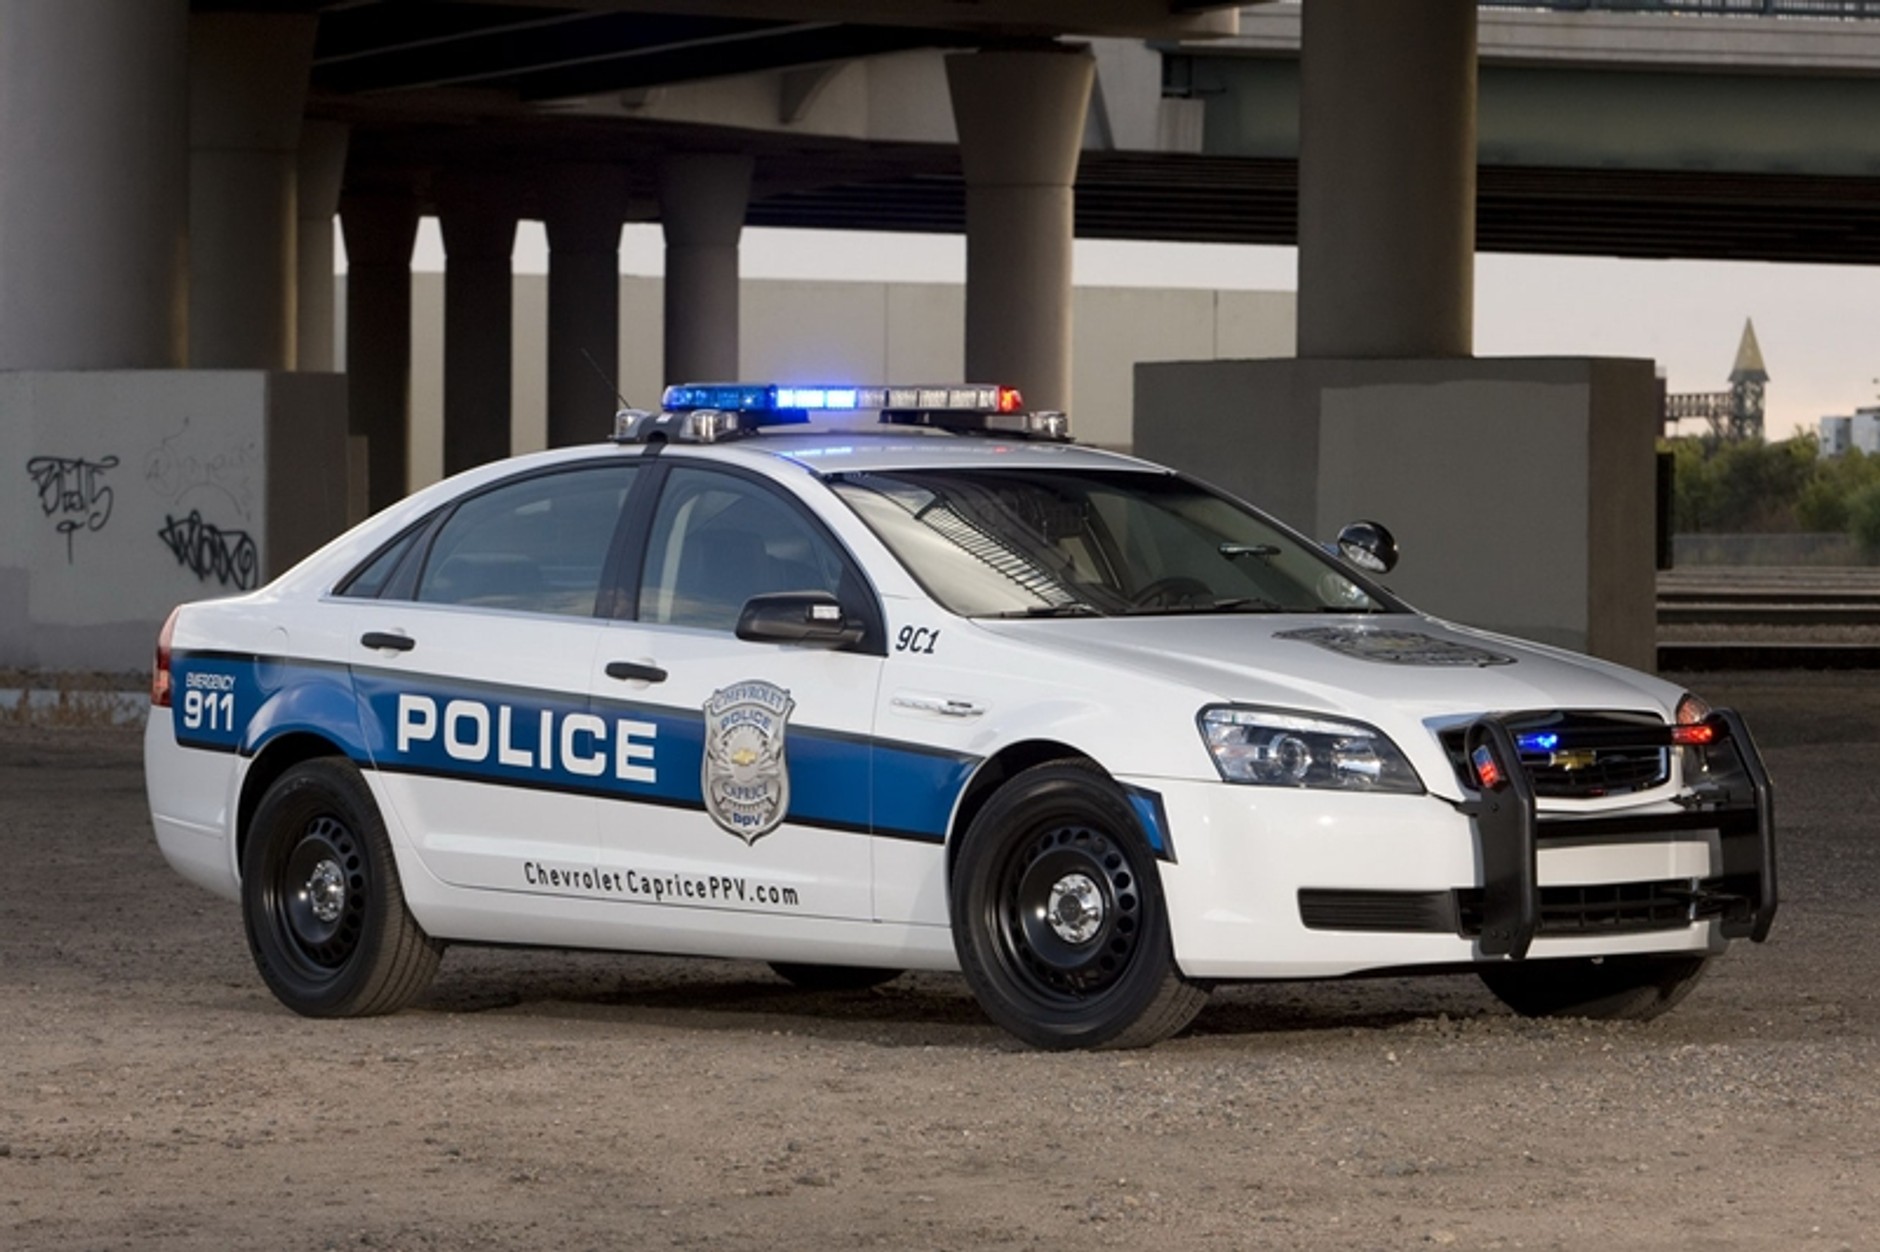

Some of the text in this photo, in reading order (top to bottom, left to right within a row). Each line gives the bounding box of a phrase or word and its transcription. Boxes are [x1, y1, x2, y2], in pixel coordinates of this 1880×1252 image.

[895, 625, 940, 654] 9C1
[186, 672, 236, 690] EMERGENCY
[184, 690, 234, 731] 911
[714, 686, 783, 710] CHEVROLET
[721, 709, 772, 731] POLICE
[397, 693, 657, 784] POLICE
